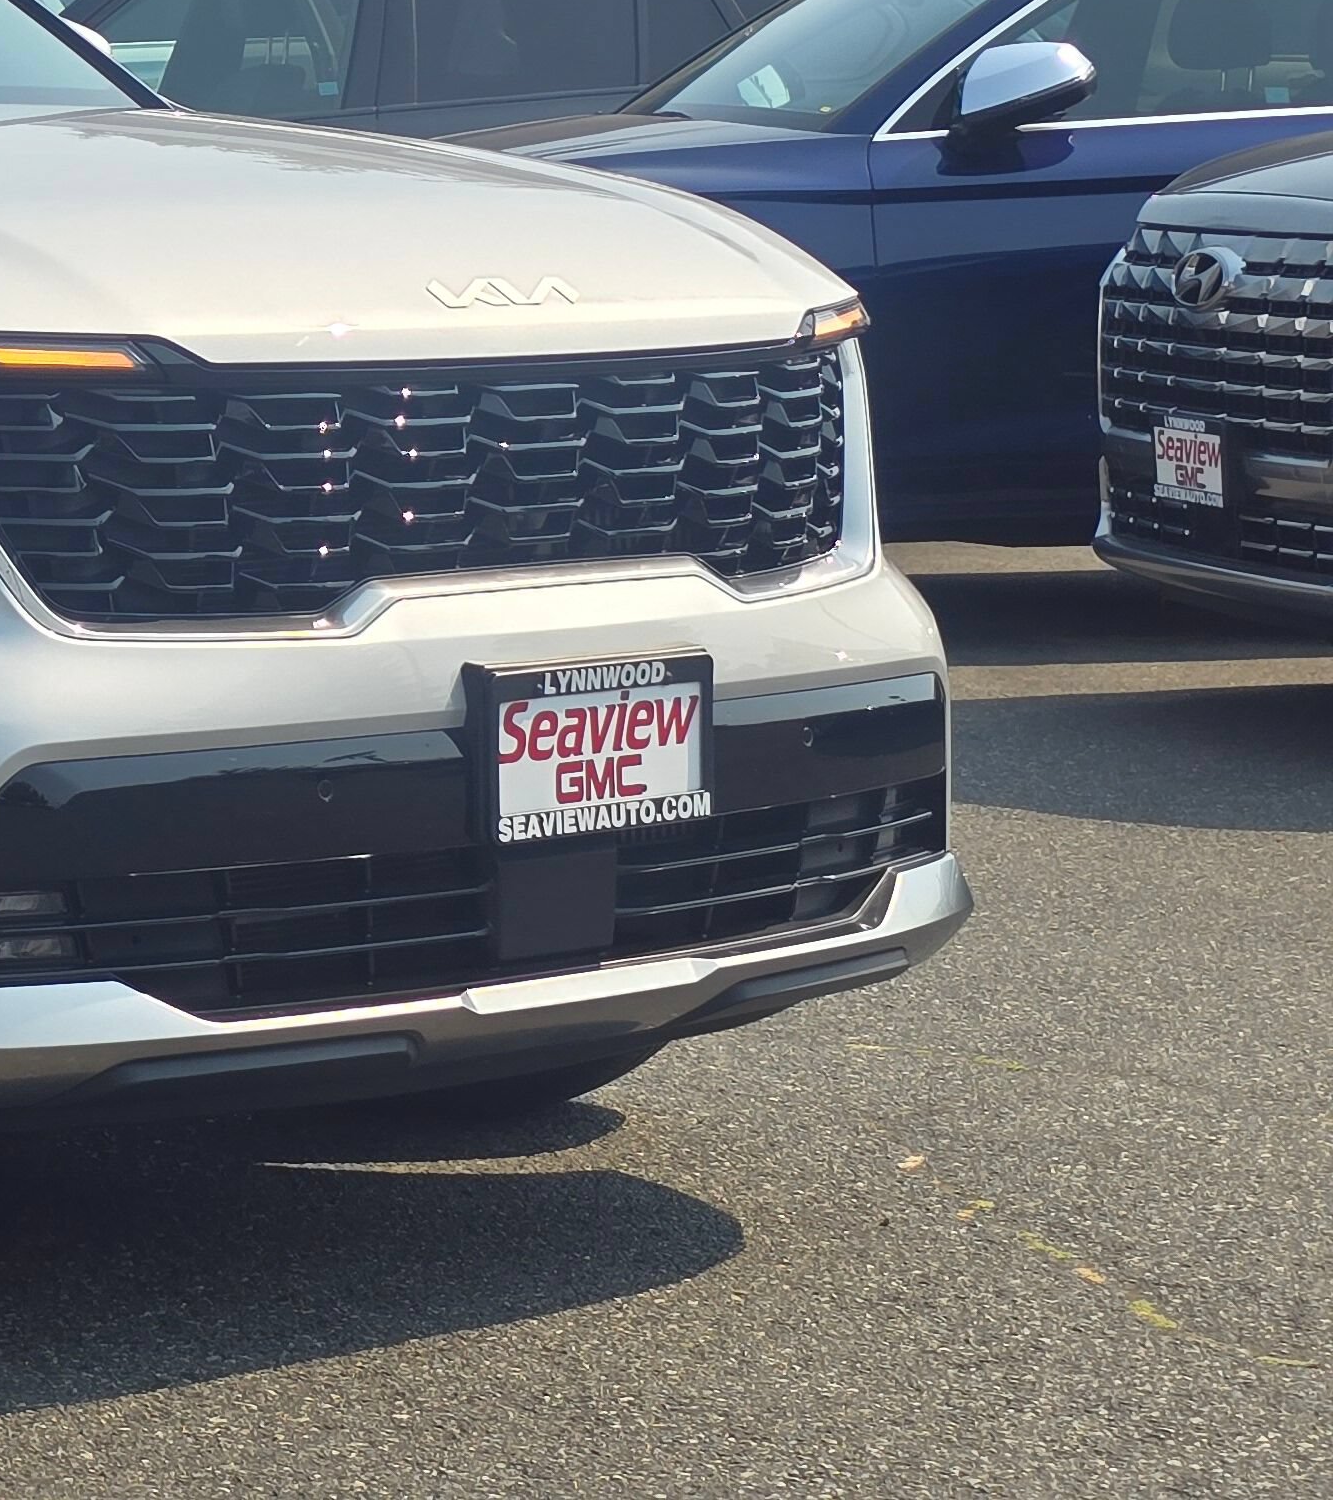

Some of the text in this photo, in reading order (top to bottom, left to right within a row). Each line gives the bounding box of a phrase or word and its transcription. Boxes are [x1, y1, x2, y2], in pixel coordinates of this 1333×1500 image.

[1157, 429, 1222, 468] Seaview
[1175, 464, 1206, 489] GMC
[543, 661, 666, 695] LYNNWOOD
[498, 690, 700, 764] Seaview
[555, 754, 648, 805] GMC
[498, 792, 711, 843] SEAVIEWAUTO.COM
